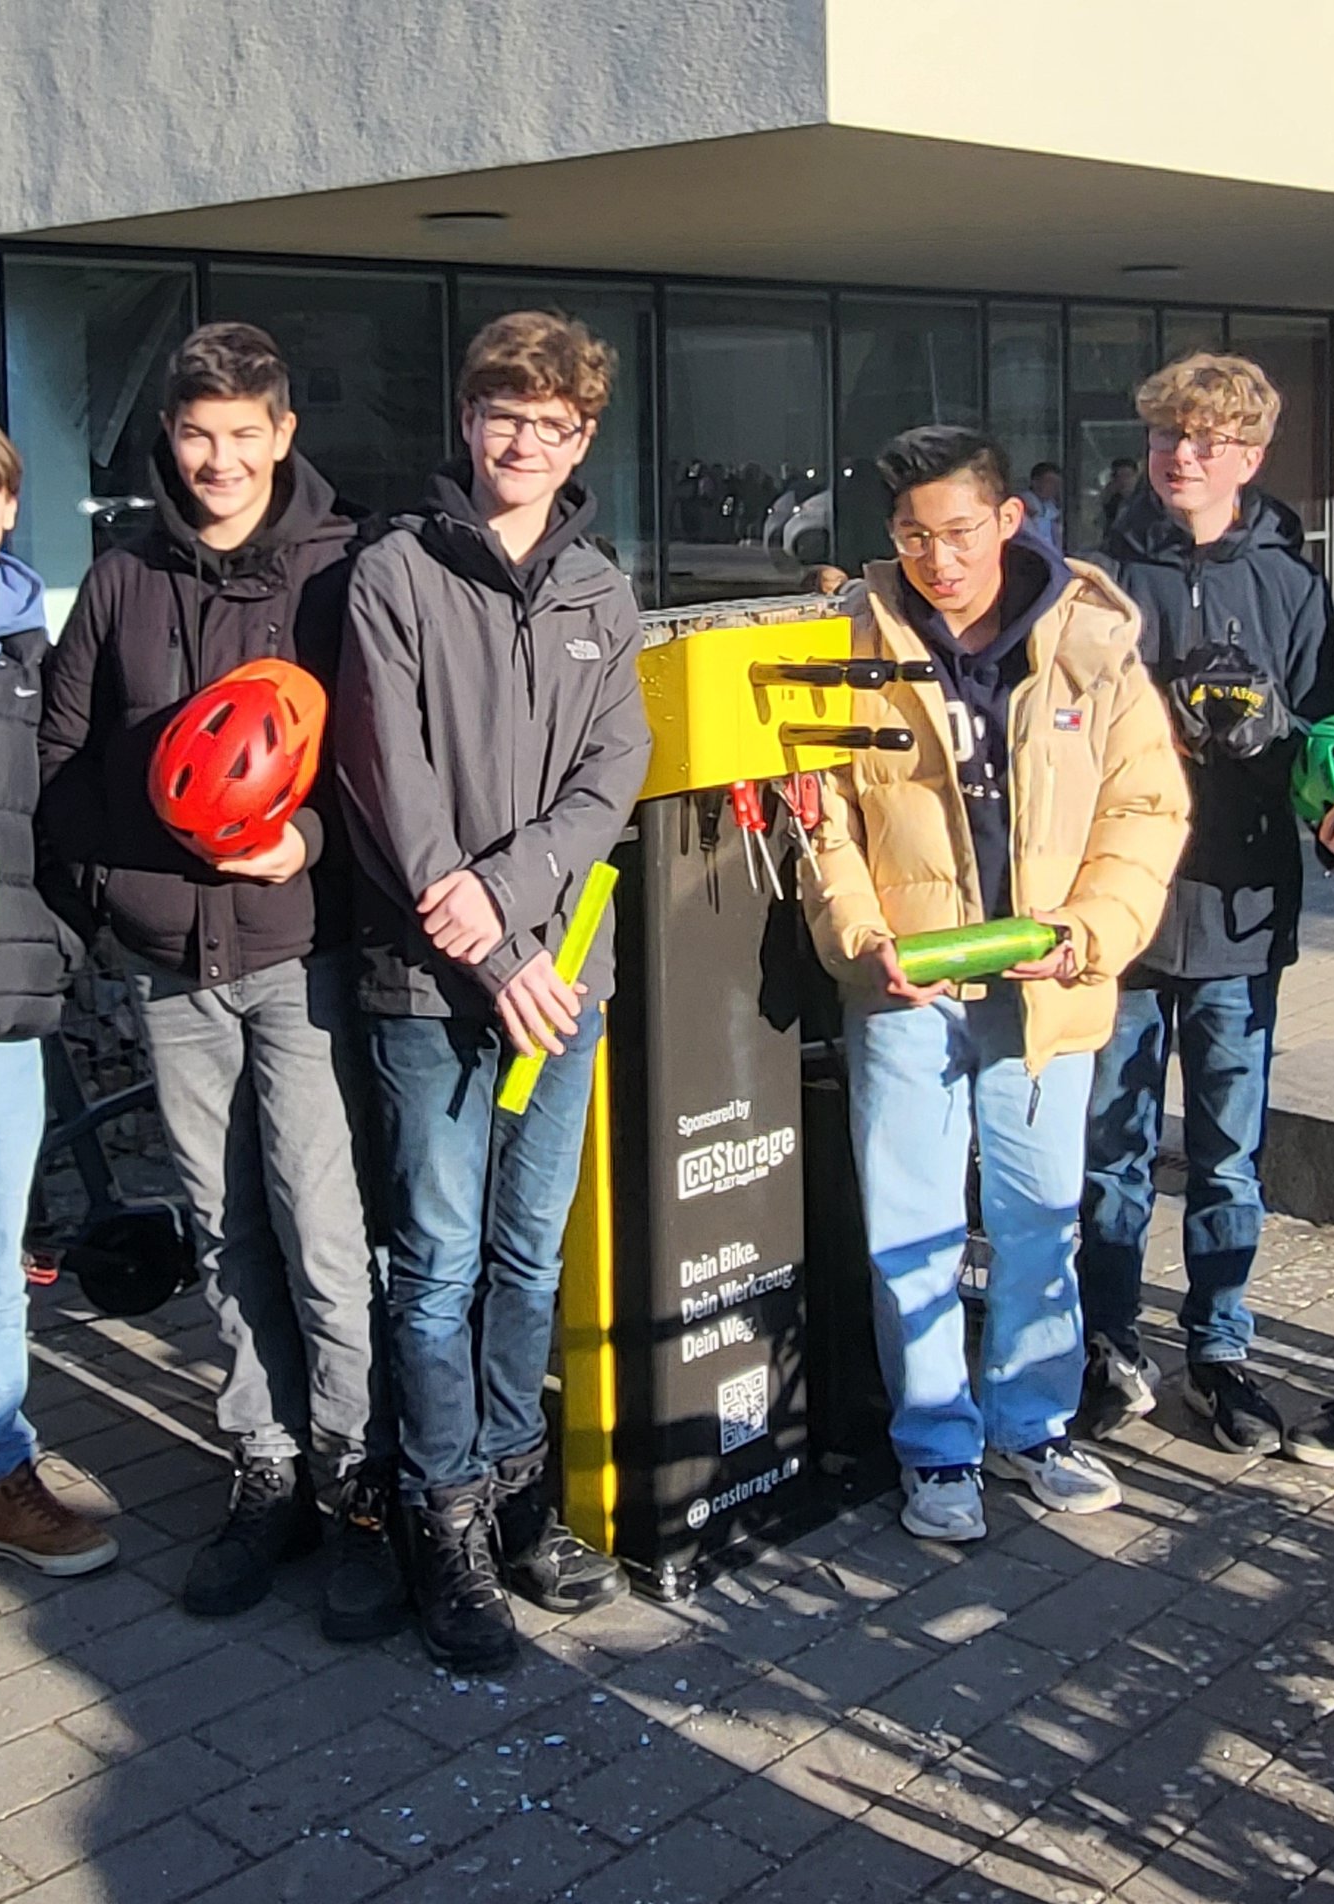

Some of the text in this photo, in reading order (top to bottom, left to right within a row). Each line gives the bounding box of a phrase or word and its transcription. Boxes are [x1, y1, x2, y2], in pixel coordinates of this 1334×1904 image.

[677, 1099, 752, 1138] Sponsored by
[684, 1126, 796, 1189] coStorage
[680, 1241, 760, 1289] Dein Bike.
[681, 1263, 796, 1325] Dein Werkzeug.
[682, 1316, 758, 1364] Dein Weg.
[712, 1457, 800, 1514] costorage.de
